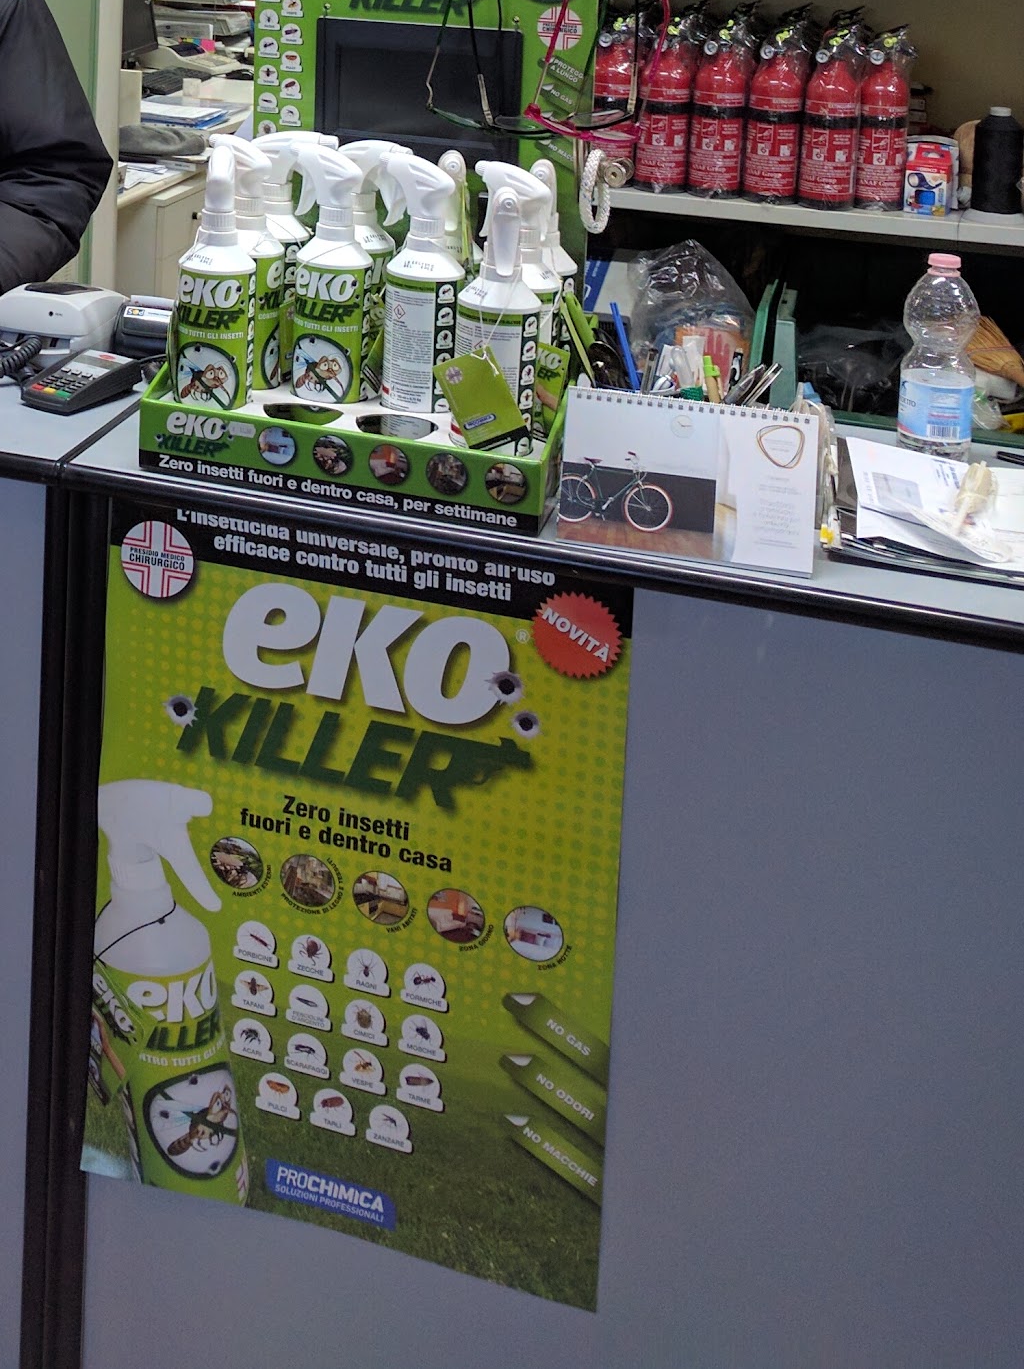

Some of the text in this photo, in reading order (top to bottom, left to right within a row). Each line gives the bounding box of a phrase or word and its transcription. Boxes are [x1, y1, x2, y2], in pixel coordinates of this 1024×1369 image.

[179, 274, 241, 309] eko
[296, 267, 356, 303] eko
[220, 332, 244, 340] INSETTI
[334, 324, 358, 332] INSETTI
[166, 411, 225, 441] eko
[159, 454, 517, 527] Zero insetti fuori e dentro casa, per settimane
[129, 553, 185, 571] CHIRURGICO
[130, 546, 185, 562] PRESIDIO MEDICO
[411, 549, 478, 574] pronto
[214, 534, 511, 602] efficace contro tutti gli insetti
[542, 607, 610, 662] NOVITÀ
[223, 583, 511, 726] eko
[177, 687, 473, 812] KILLER
[283, 795, 410, 840] Zero insetti
[240, 808, 452, 873] fuori e dentro casa
[297, 964, 324, 976] ZECCHE
[355, 980, 376, 990] RAGNI
[242, 999, 265, 1010] TAFANI
[406, 992, 442, 1007] FORMICHE
[353, 1029, 375, 1040] CIMICI
[546, 1019, 591, 1056] NO GAS
[242, 1046, 263, 1057] ACARI
[406, 1043, 437, 1057] MOSCHE
[352, 1077, 374, 1088] VESPE
[268, 1102, 288, 1113] PULCI
[408, 1093, 431, 1105] TARME
[536, 1074, 595, 1121] NO ODORI
[324, 1118, 342, 1128] TARLI
[373, 1133, 405, 1148] ZANZARE
[523, 1127, 598, 1187] NO MACCHIE
[276, 1166, 384, 1213] PROCHIMICA
[275, 1184, 384, 1223] SOLUZIONI PROFESSIONALI
